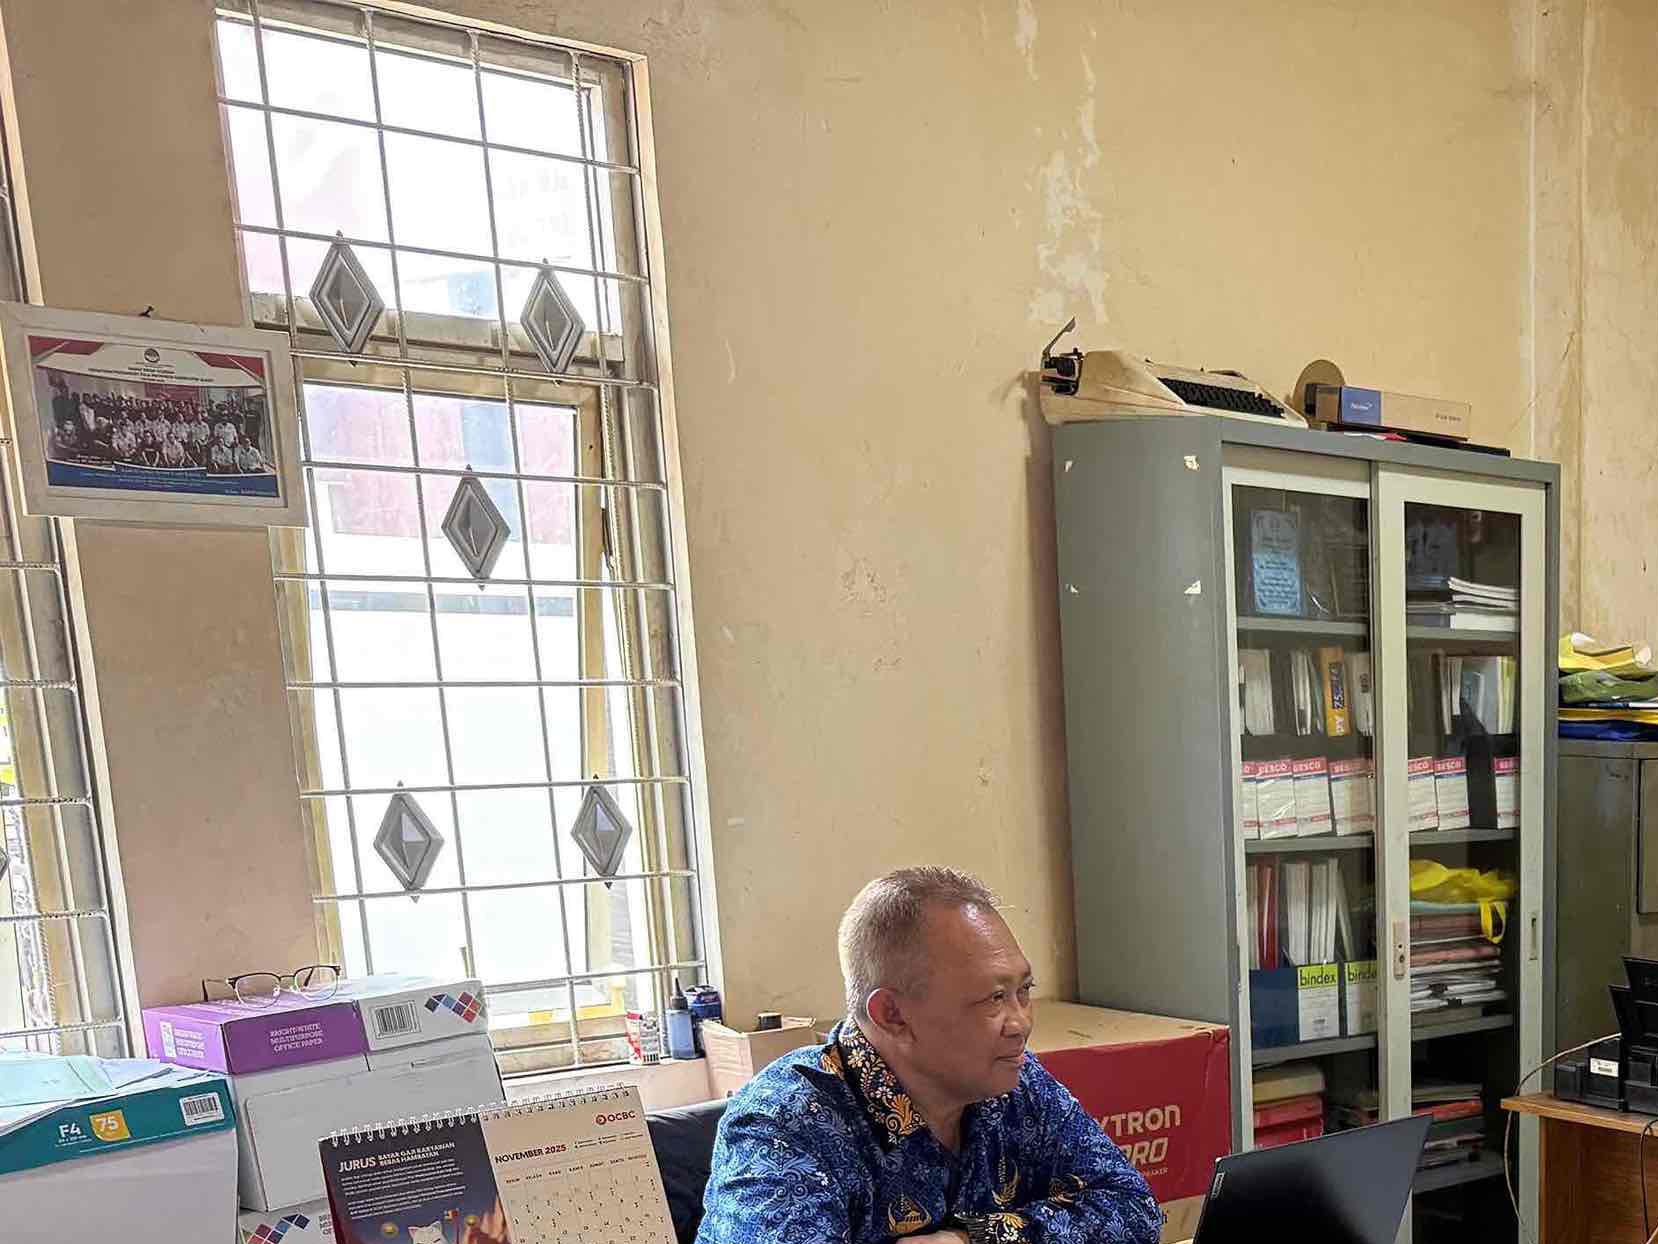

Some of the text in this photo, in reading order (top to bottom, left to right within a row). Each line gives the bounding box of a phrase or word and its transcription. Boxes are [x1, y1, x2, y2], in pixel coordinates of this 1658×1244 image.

[1300, 967, 1337, 987] bindex
[95, 1115, 120, 1132] 75
[607, 1110, 637, 1123] OCBC
[58, 1123, 82, 1138] F4
[494, 1143, 568, 1164] NOVEMBER 2025
[338, 1156, 377, 1173] JURUS
